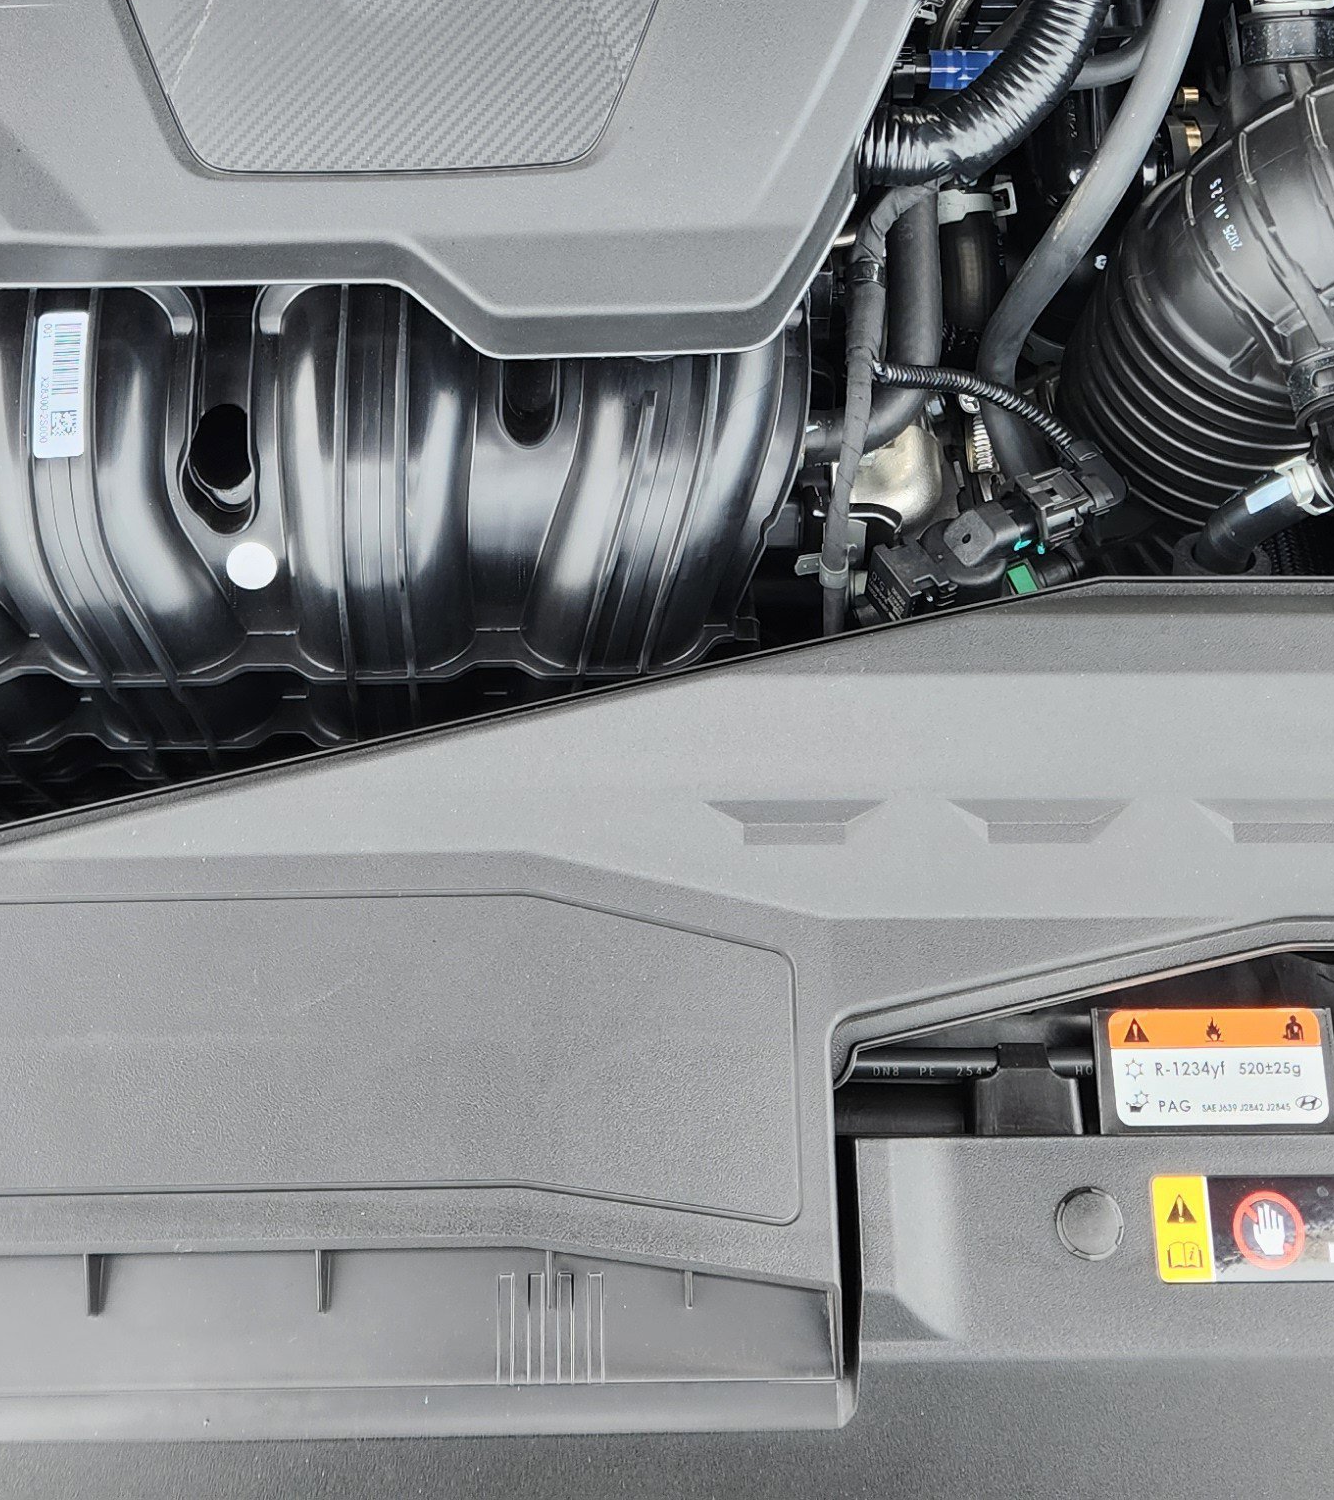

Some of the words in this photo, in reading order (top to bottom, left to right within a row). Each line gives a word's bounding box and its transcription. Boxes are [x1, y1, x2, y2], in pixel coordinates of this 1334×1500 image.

[872, 1066, 900, 1077] DN8
[919, 1066, 936, 1077] PE
[1076, 1065, 1094, 1076] HO
[1154, 1061, 1226, 1080] R-1234yf
[1239, 1061, 1302, 1078] 520±25g
[1159, 1100, 1192, 1113] PAG
[1202, 1104, 1217, 1113] SAE
